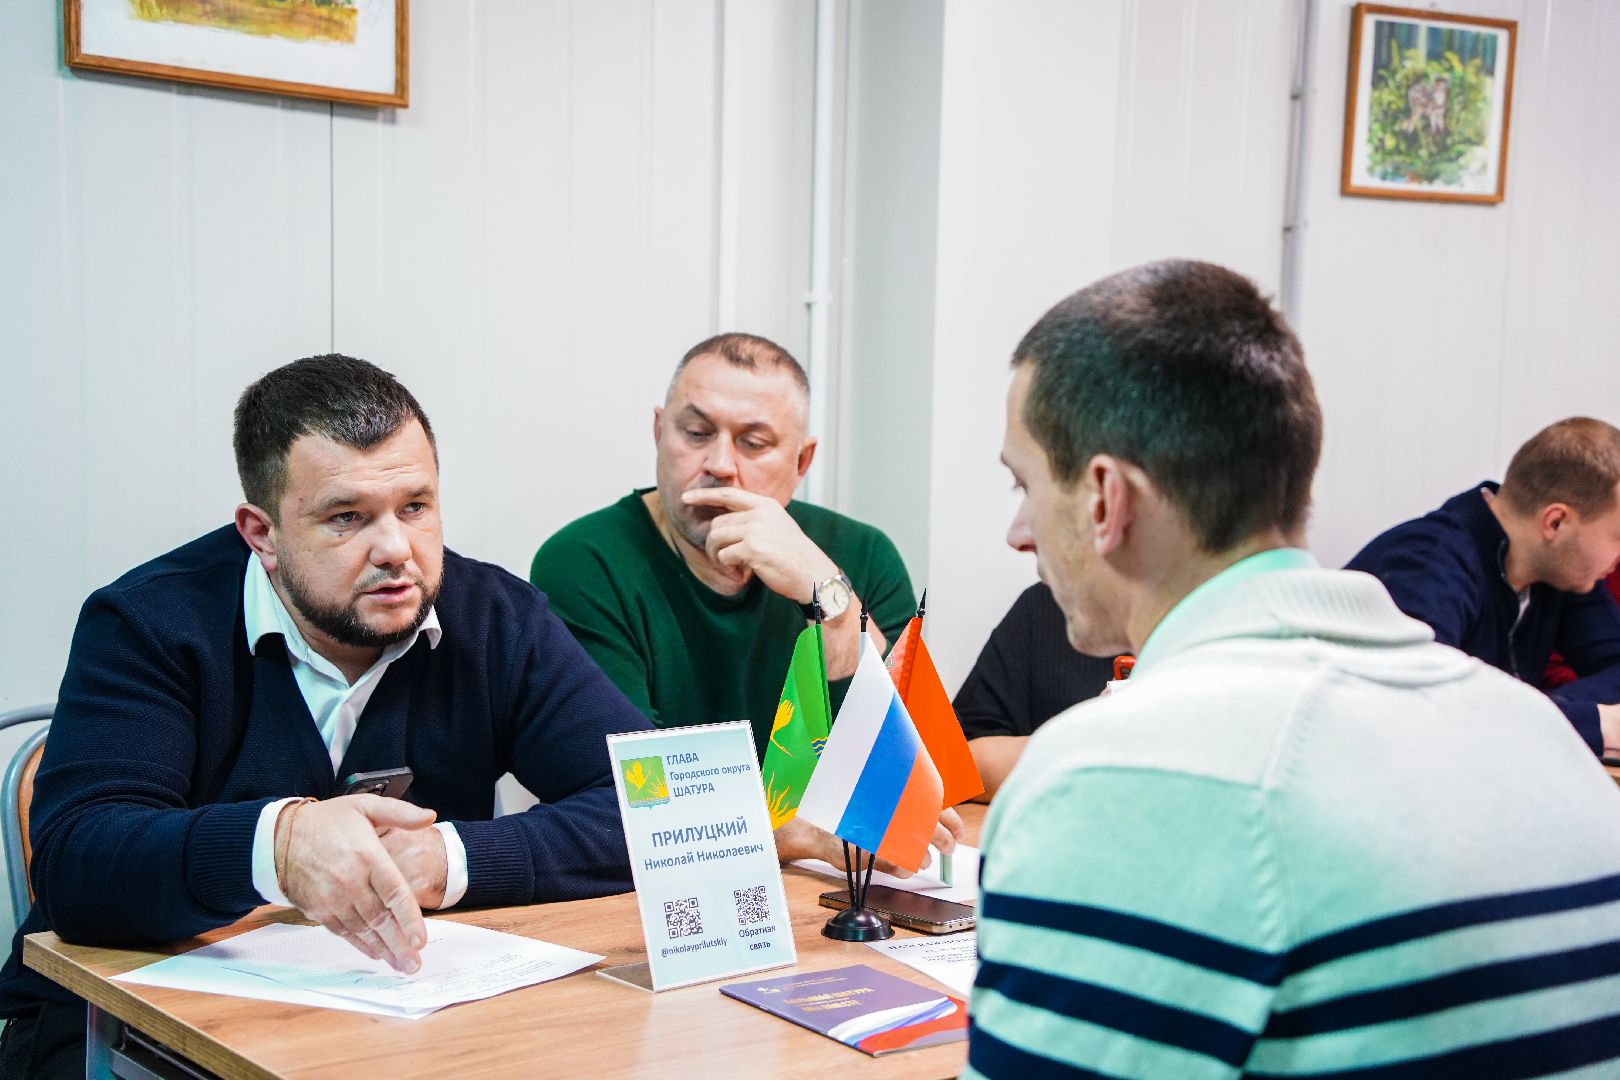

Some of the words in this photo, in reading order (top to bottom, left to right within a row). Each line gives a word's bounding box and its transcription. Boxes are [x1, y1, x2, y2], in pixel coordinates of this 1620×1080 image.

[666, 753, 700, 766] ГЛАВА
[669, 767, 720, 782] Городского
[721, 763, 751, 775] округа
[673, 782, 715, 798] ШАТУРА
[652, 815, 748, 848] ПРИЛУЦКИЙ
[644, 851, 695, 871] Николай
[696, 843, 764, 862] Николаевич
[738, 925, 776, 938] Обратная
[661, 937, 728, 958] @nikolayprilutskiy
[749, 941, 771, 951] связь
